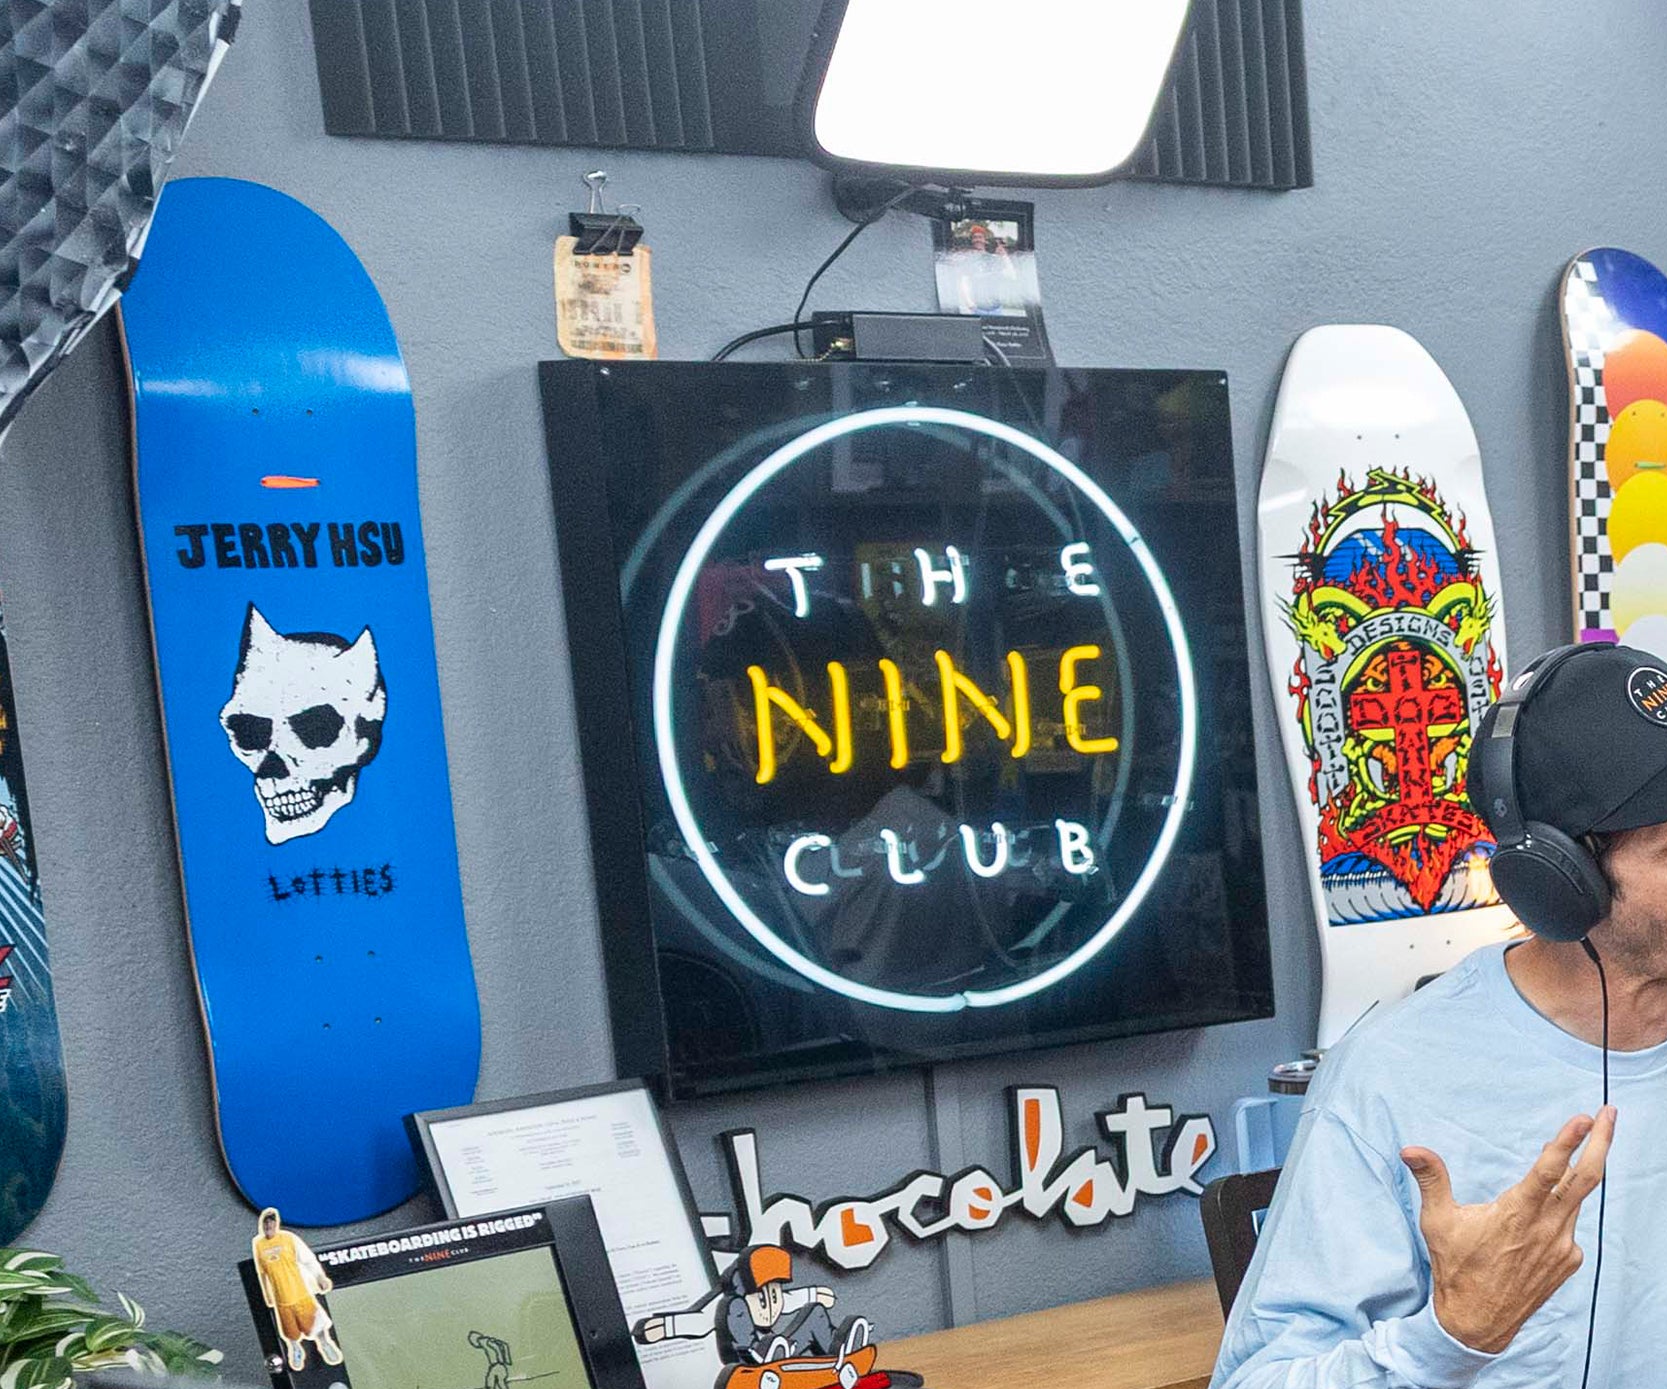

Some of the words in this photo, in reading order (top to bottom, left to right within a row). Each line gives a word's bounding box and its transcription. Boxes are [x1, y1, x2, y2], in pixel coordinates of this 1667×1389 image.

[174, 522, 317, 570] JERRY
[331, 521, 406, 566] HSU
[763, 540, 1101, 619] THE
[1634, 675, 1664, 698] THE
[746, 642, 1119, 786] NINE
[781, 818, 1099, 897] CLUB
[424, 1248, 451, 1264] NINE
[461, 1222, 478, 1243] IS
